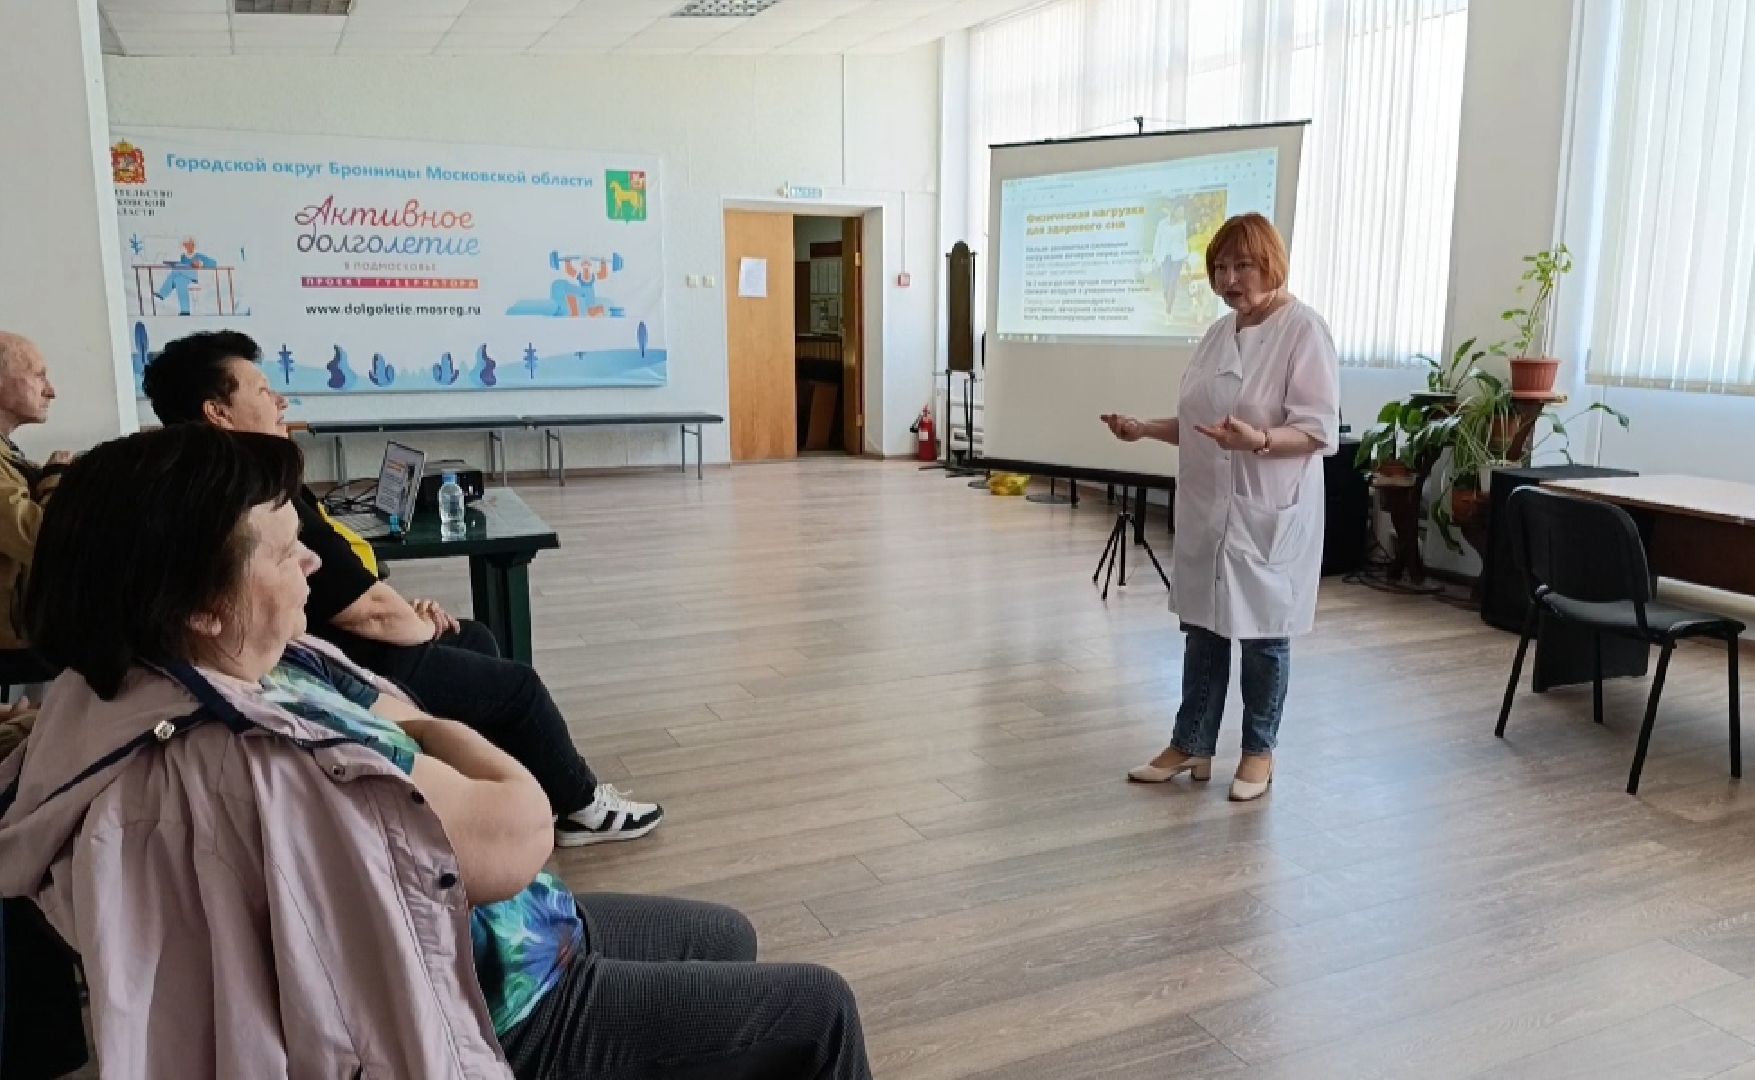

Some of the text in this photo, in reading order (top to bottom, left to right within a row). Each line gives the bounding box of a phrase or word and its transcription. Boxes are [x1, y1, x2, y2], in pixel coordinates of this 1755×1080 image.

[166, 153, 593, 188] Городской округ Бронницы Московской области
[294, 194, 475, 229] Активное
[1092, 206, 1145, 218] нагрузка
[297, 222, 480, 256] долголетие
[353, 262, 436, 272] ПОДМОСКОВЬЕ
[306, 277, 477, 288] ПРОЕКТ ГУБЕРНАТОРА
[305, 301, 481, 317] www.dolgoletie.mosreg.ru
